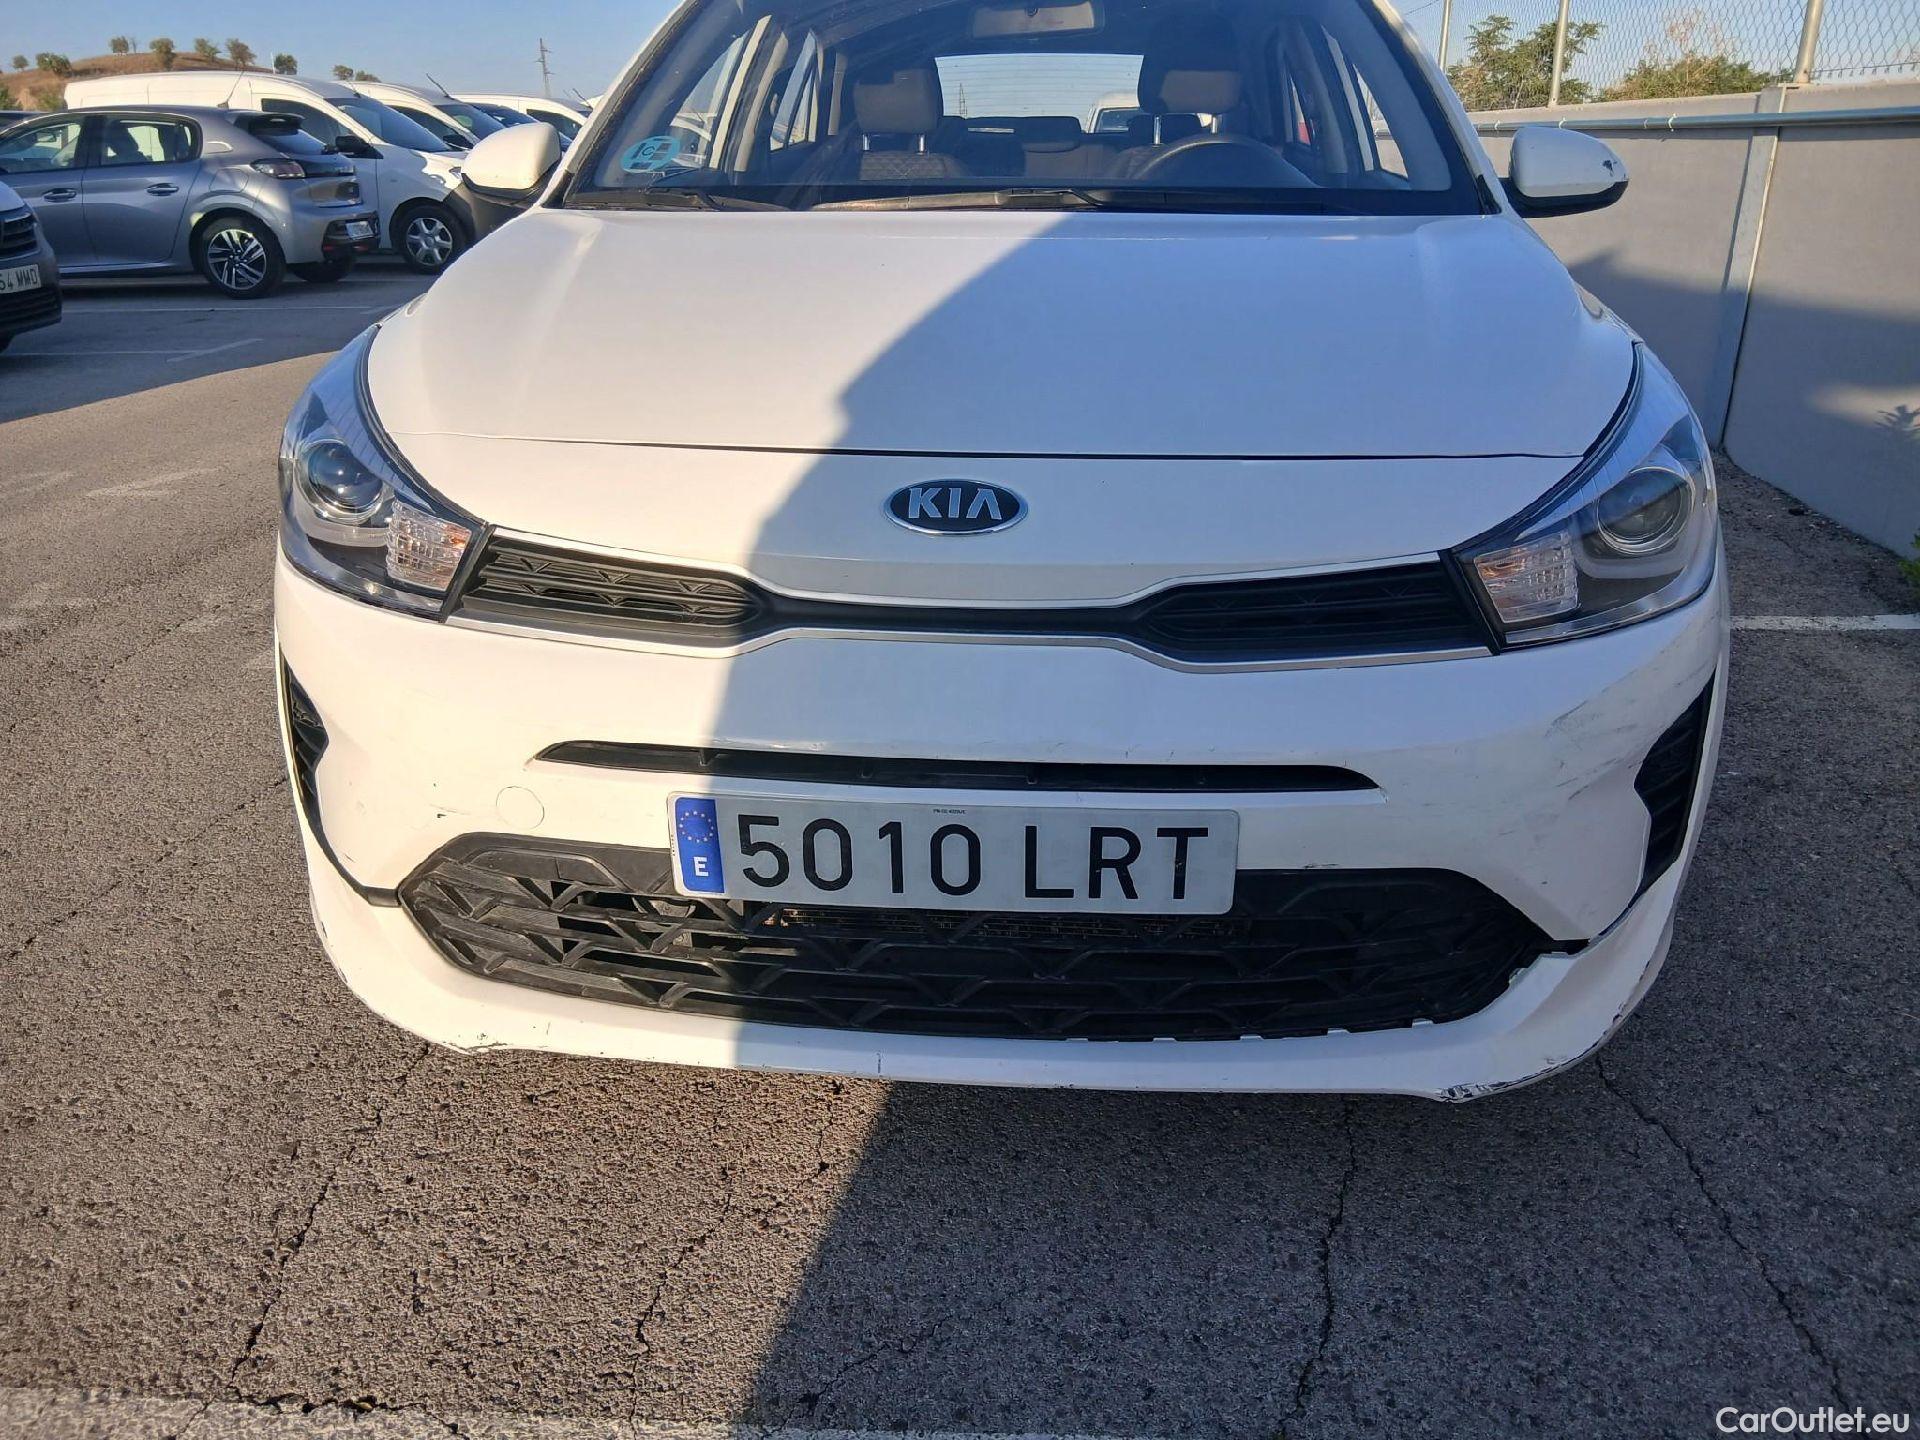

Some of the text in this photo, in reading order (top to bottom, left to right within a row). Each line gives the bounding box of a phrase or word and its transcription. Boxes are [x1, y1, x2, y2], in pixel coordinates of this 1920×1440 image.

[908, 487, 1002, 520] KIA
[693, 856, 709, 877] E
[737, 813, 1209, 900] 5010 LRT
